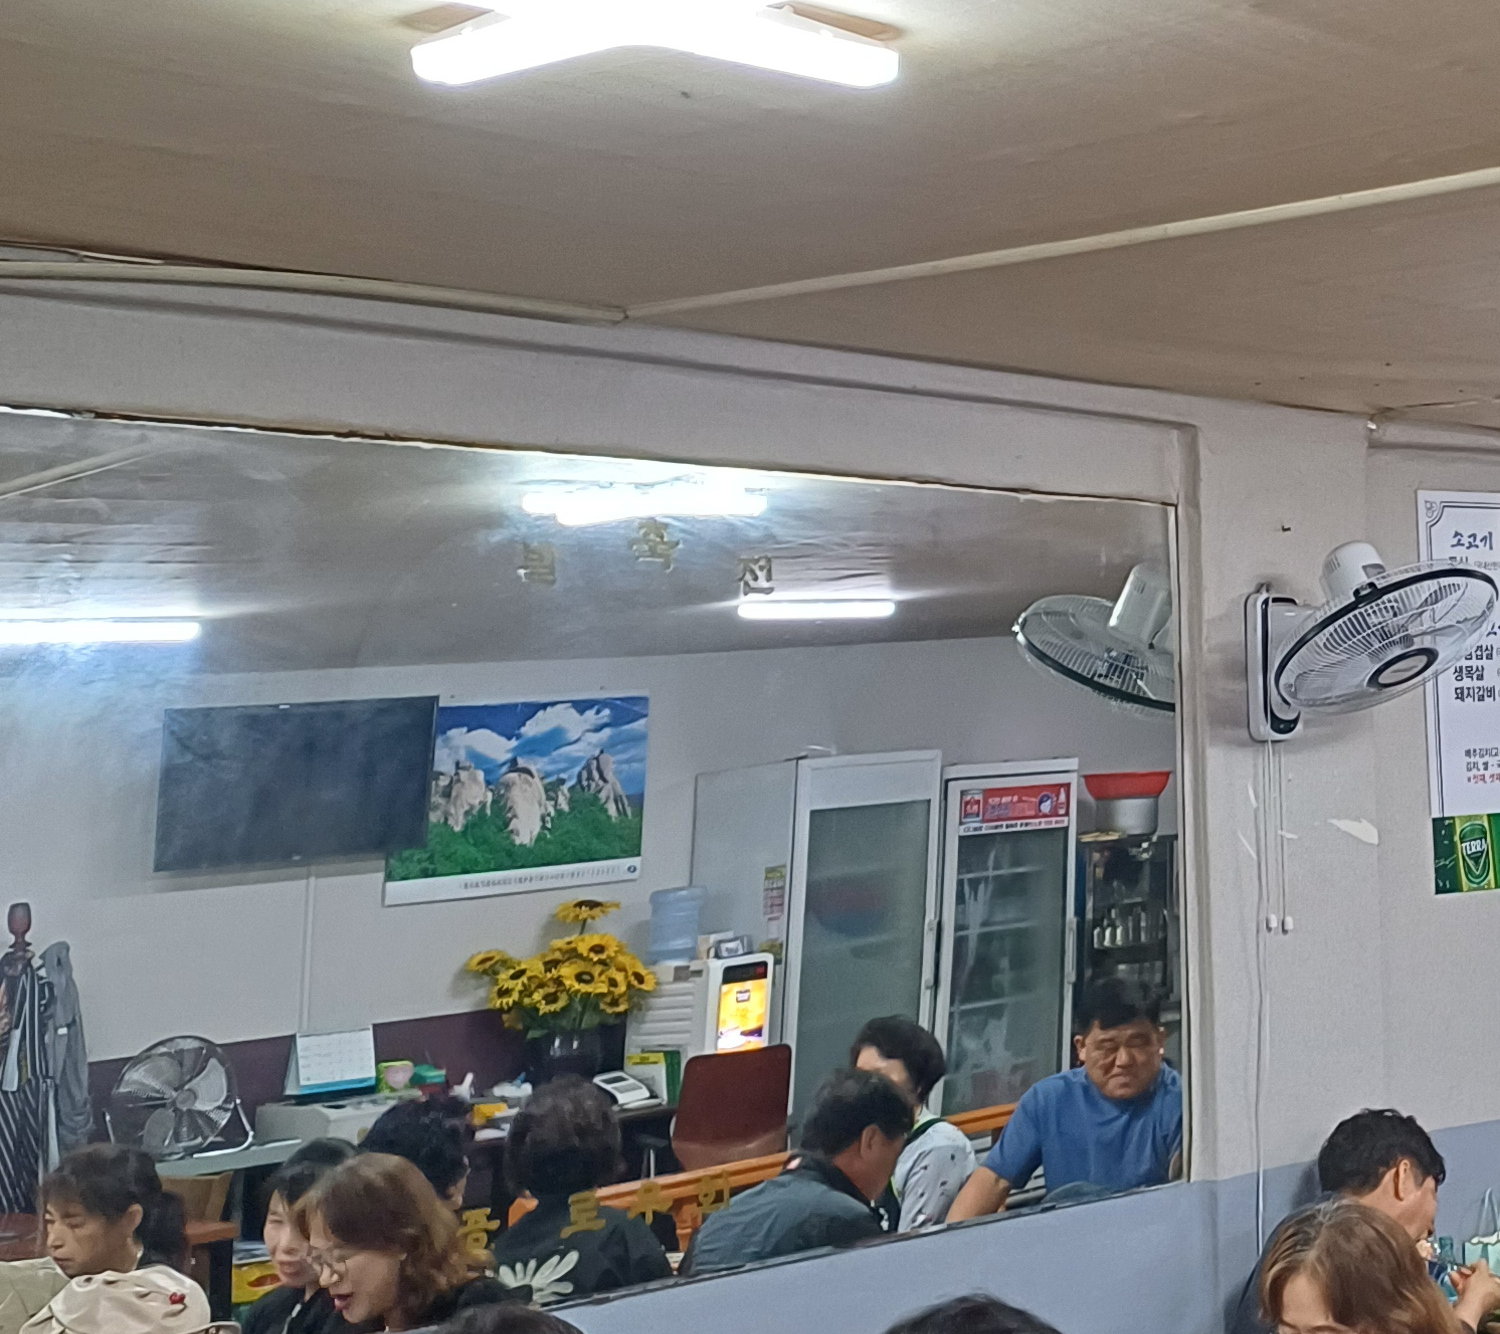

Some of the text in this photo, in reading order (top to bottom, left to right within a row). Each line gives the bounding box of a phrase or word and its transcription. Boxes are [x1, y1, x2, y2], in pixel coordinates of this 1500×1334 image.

[1451, 530, 1493, 550] 소고기
[1453, 665, 1485, 681] 생목살
[1454, 685, 1496, 702] 돼지갈비
[1461, 838, 1487, 855] TERRA
